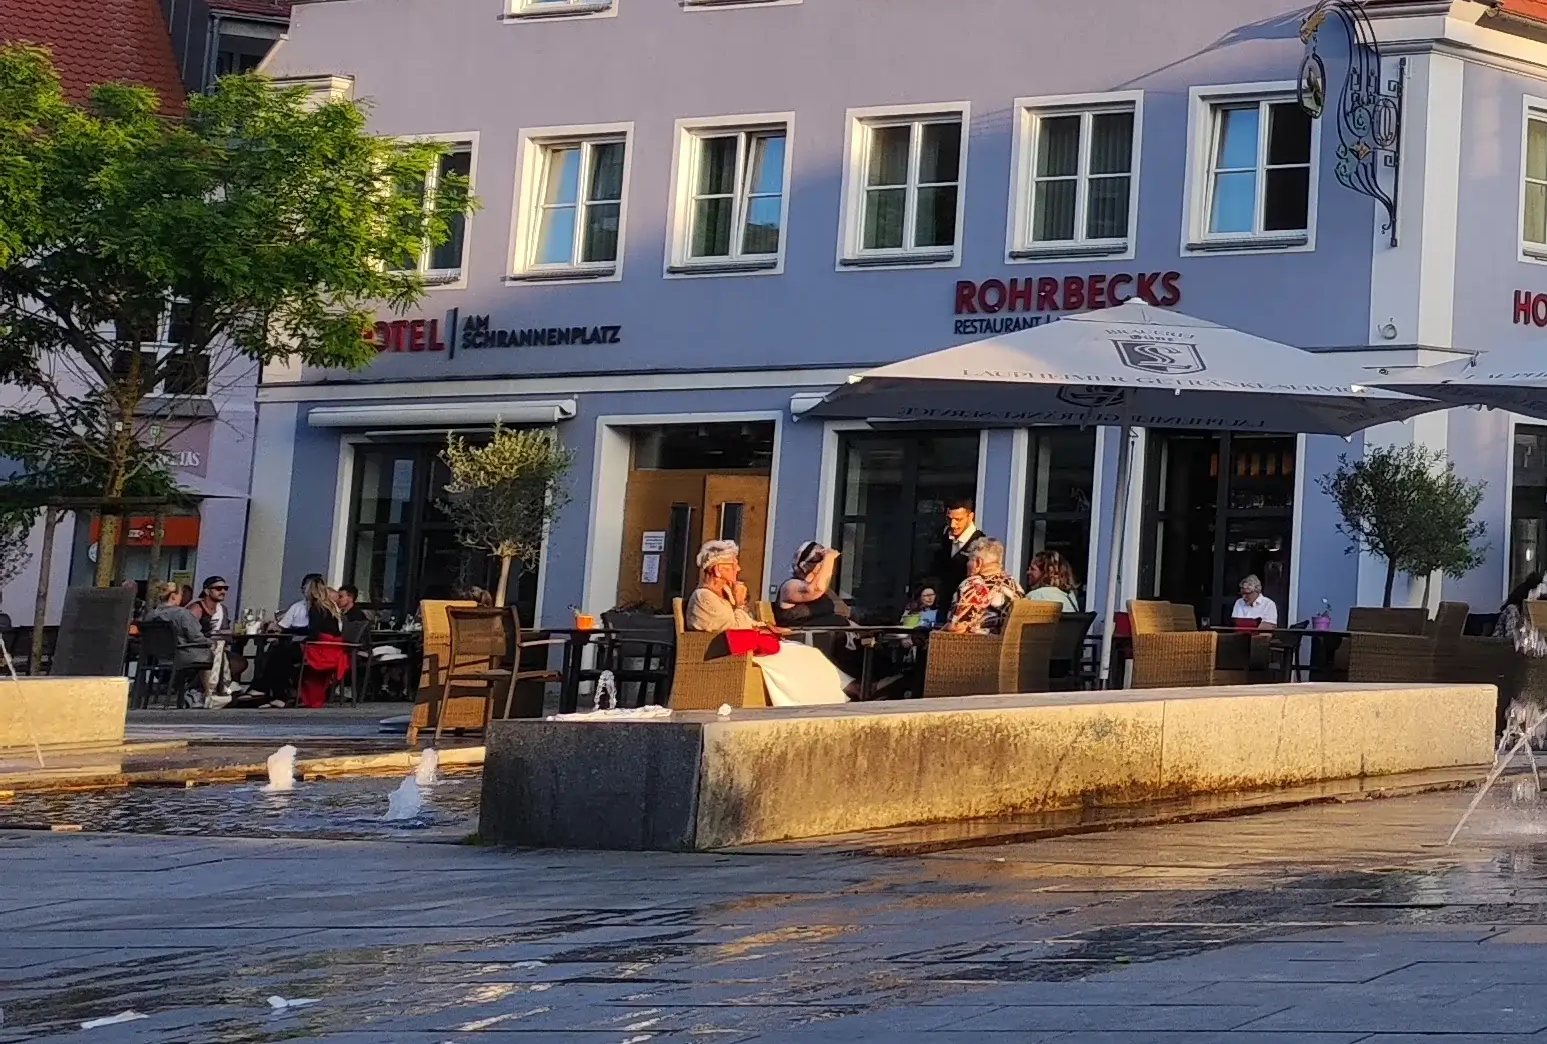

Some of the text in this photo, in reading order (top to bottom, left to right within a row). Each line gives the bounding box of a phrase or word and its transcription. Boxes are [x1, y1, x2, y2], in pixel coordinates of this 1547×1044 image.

[953, 271, 1181, 315] ROHRBECKS
[463, 314, 489, 331] AM
[953, 316, 1043, 336] RESTAURANT
[462, 325, 622, 349] SCHRANNENPLATZ
